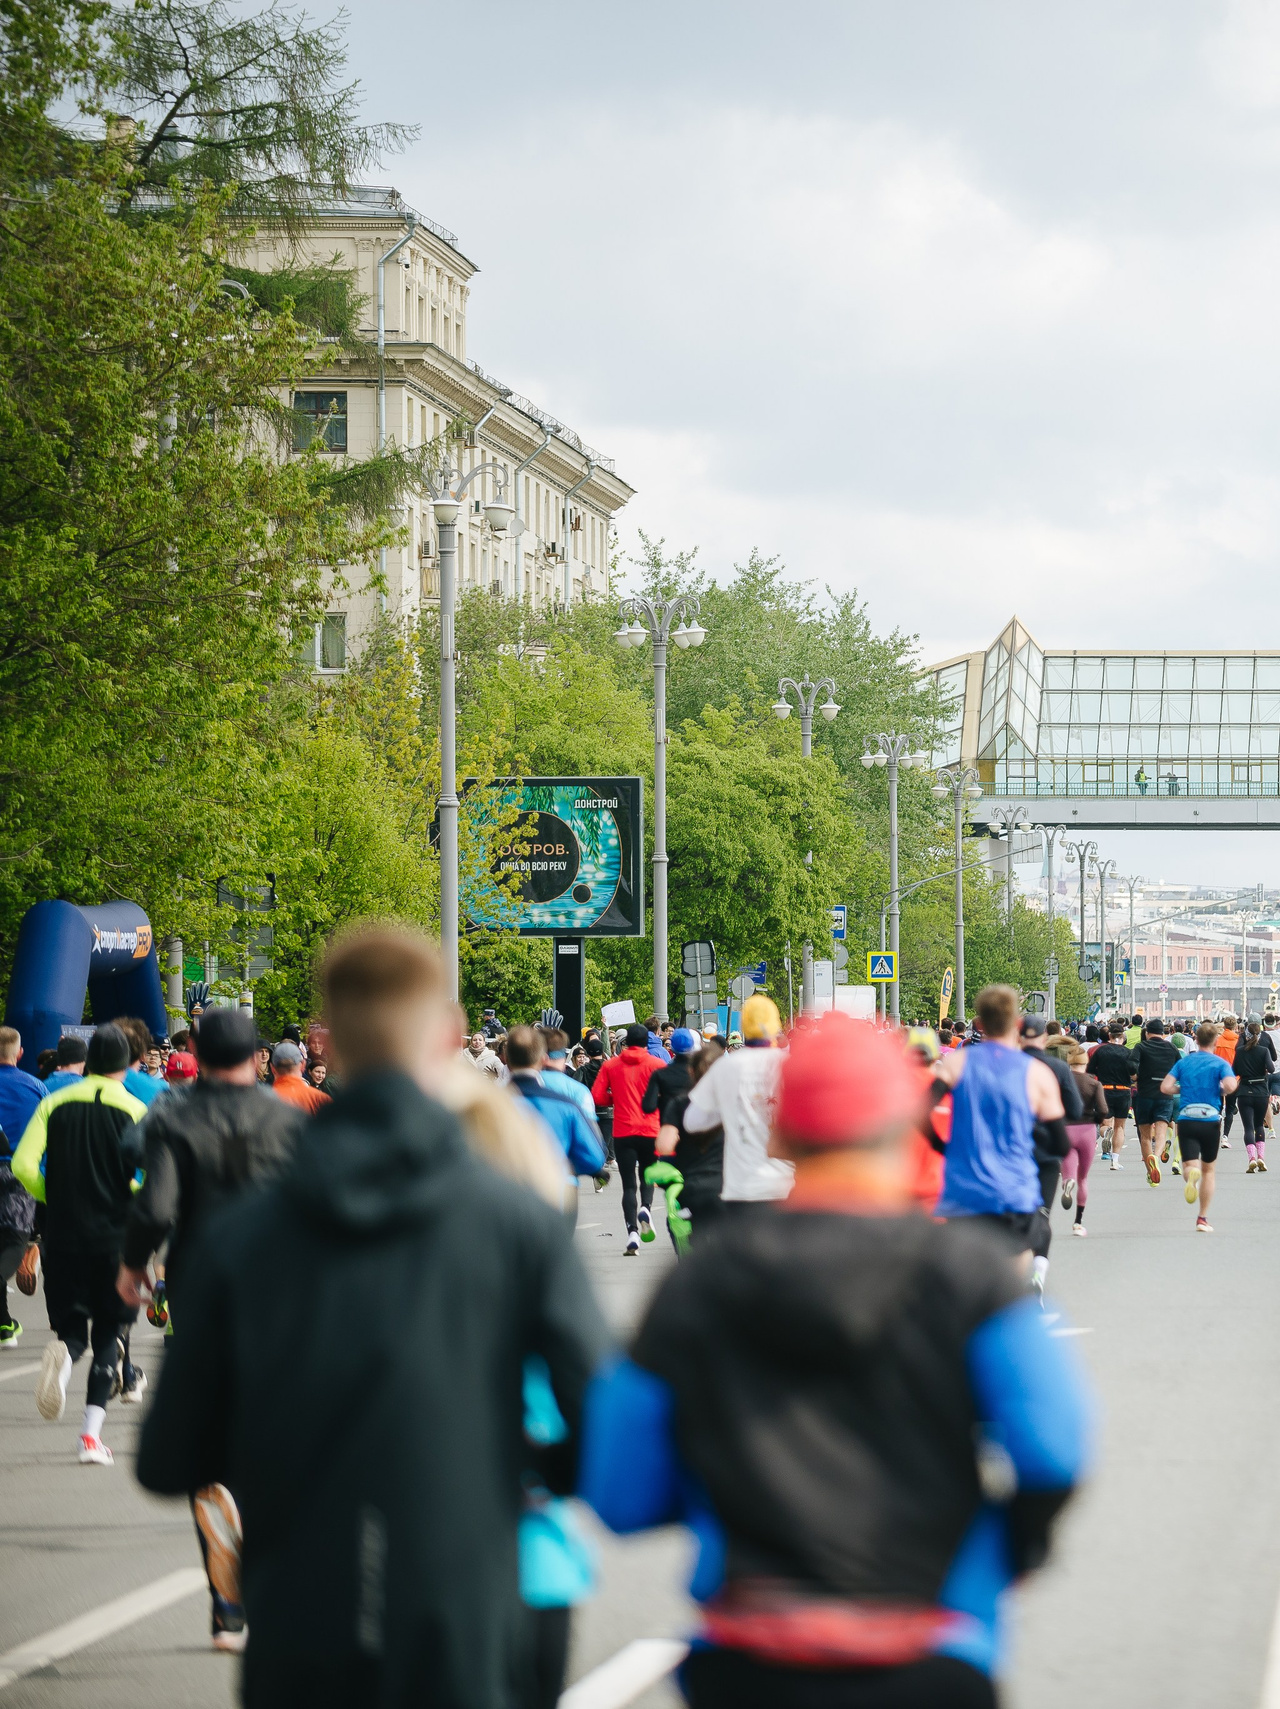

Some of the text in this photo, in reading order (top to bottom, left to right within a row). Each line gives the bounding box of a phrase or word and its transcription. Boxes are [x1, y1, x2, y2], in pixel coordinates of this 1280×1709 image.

[574, 797, 618, 809] ДОНСТРОЙ
[520, 861, 530, 871] ВО
[532, 861, 548, 871] ВСЮ
[549, 861, 567, 871] РЕКУ
